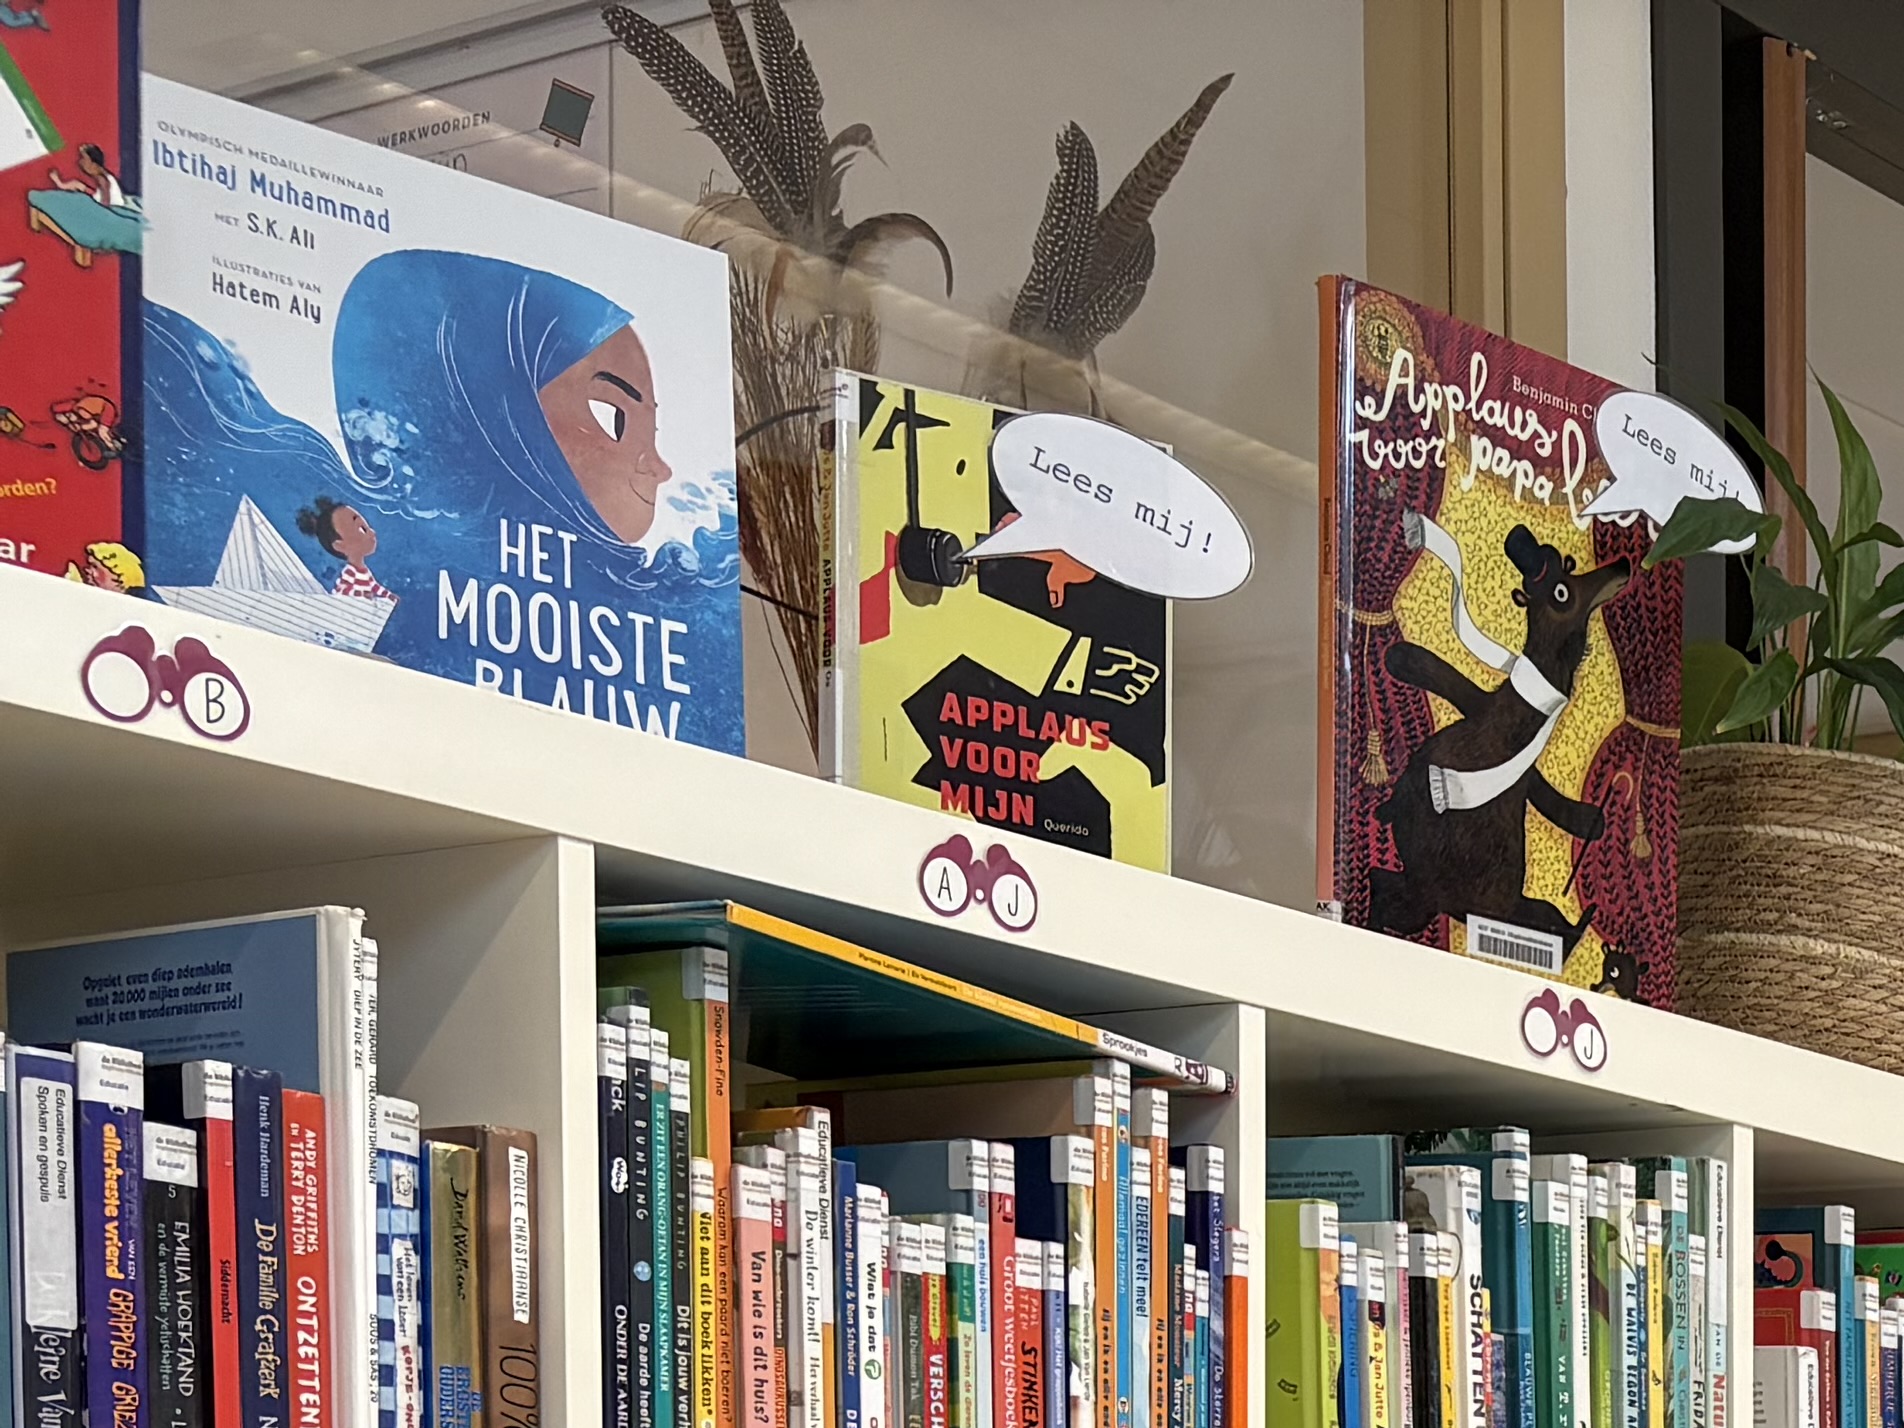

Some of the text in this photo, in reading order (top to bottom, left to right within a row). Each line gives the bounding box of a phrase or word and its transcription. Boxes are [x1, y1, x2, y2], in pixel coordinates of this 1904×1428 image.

[157, 120, 384, 197] OLYMPISCH MEDAILLEWINNAAR
[152, 139, 391, 234] Ibtihaj Muhammad
[247, 212, 284, 242] S.K.
[212, 272, 322, 324] Hatem Aly
[298, 279, 322, 294] VAN
[1356, 347, 1558, 458] Applaus
[1513, 375, 1578, 416] Benjamin
[1622, 414, 1677, 465] Lees
[1350, 430, 1447, 470] voor
[1460, 434, 1554, 506] papa
[1027, 446, 1213, 555] Lees mij!
[499, 518, 578, 589] HET
[438, 569, 691, 696] MOOISTE
[205, 678, 225, 724] B
[939, 691, 1111, 752] APPLAUS
[939, 735, 1041, 784] VOOR
[939, 779, 1035, 827] MIJN
[1044, 818, 1089, 837] Querido
[937, 866, 1020, 918] A J
[1102, 1032, 1148, 1059] Sprookjes
[1583, 1029, 1595, 1061] J
[291, 1142, 305, 1256] TERRY DENTON
[304, 1129, 319, 1253] ANDY GRIFFITHS
[513, 1154, 528, 1316] NICOLLE CHRISTIAANSE
[259, 1254, 279, 1310] Familie
[751, 1250, 767, 1283] Van
[109, 1288, 137, 1371] GRAPPIGE
[174, 1222, 196, 1397] EMILIA HOEKTAND
[754, 1344, 769, 1373] dit
[753, 1380, 769, 1425] huis?
